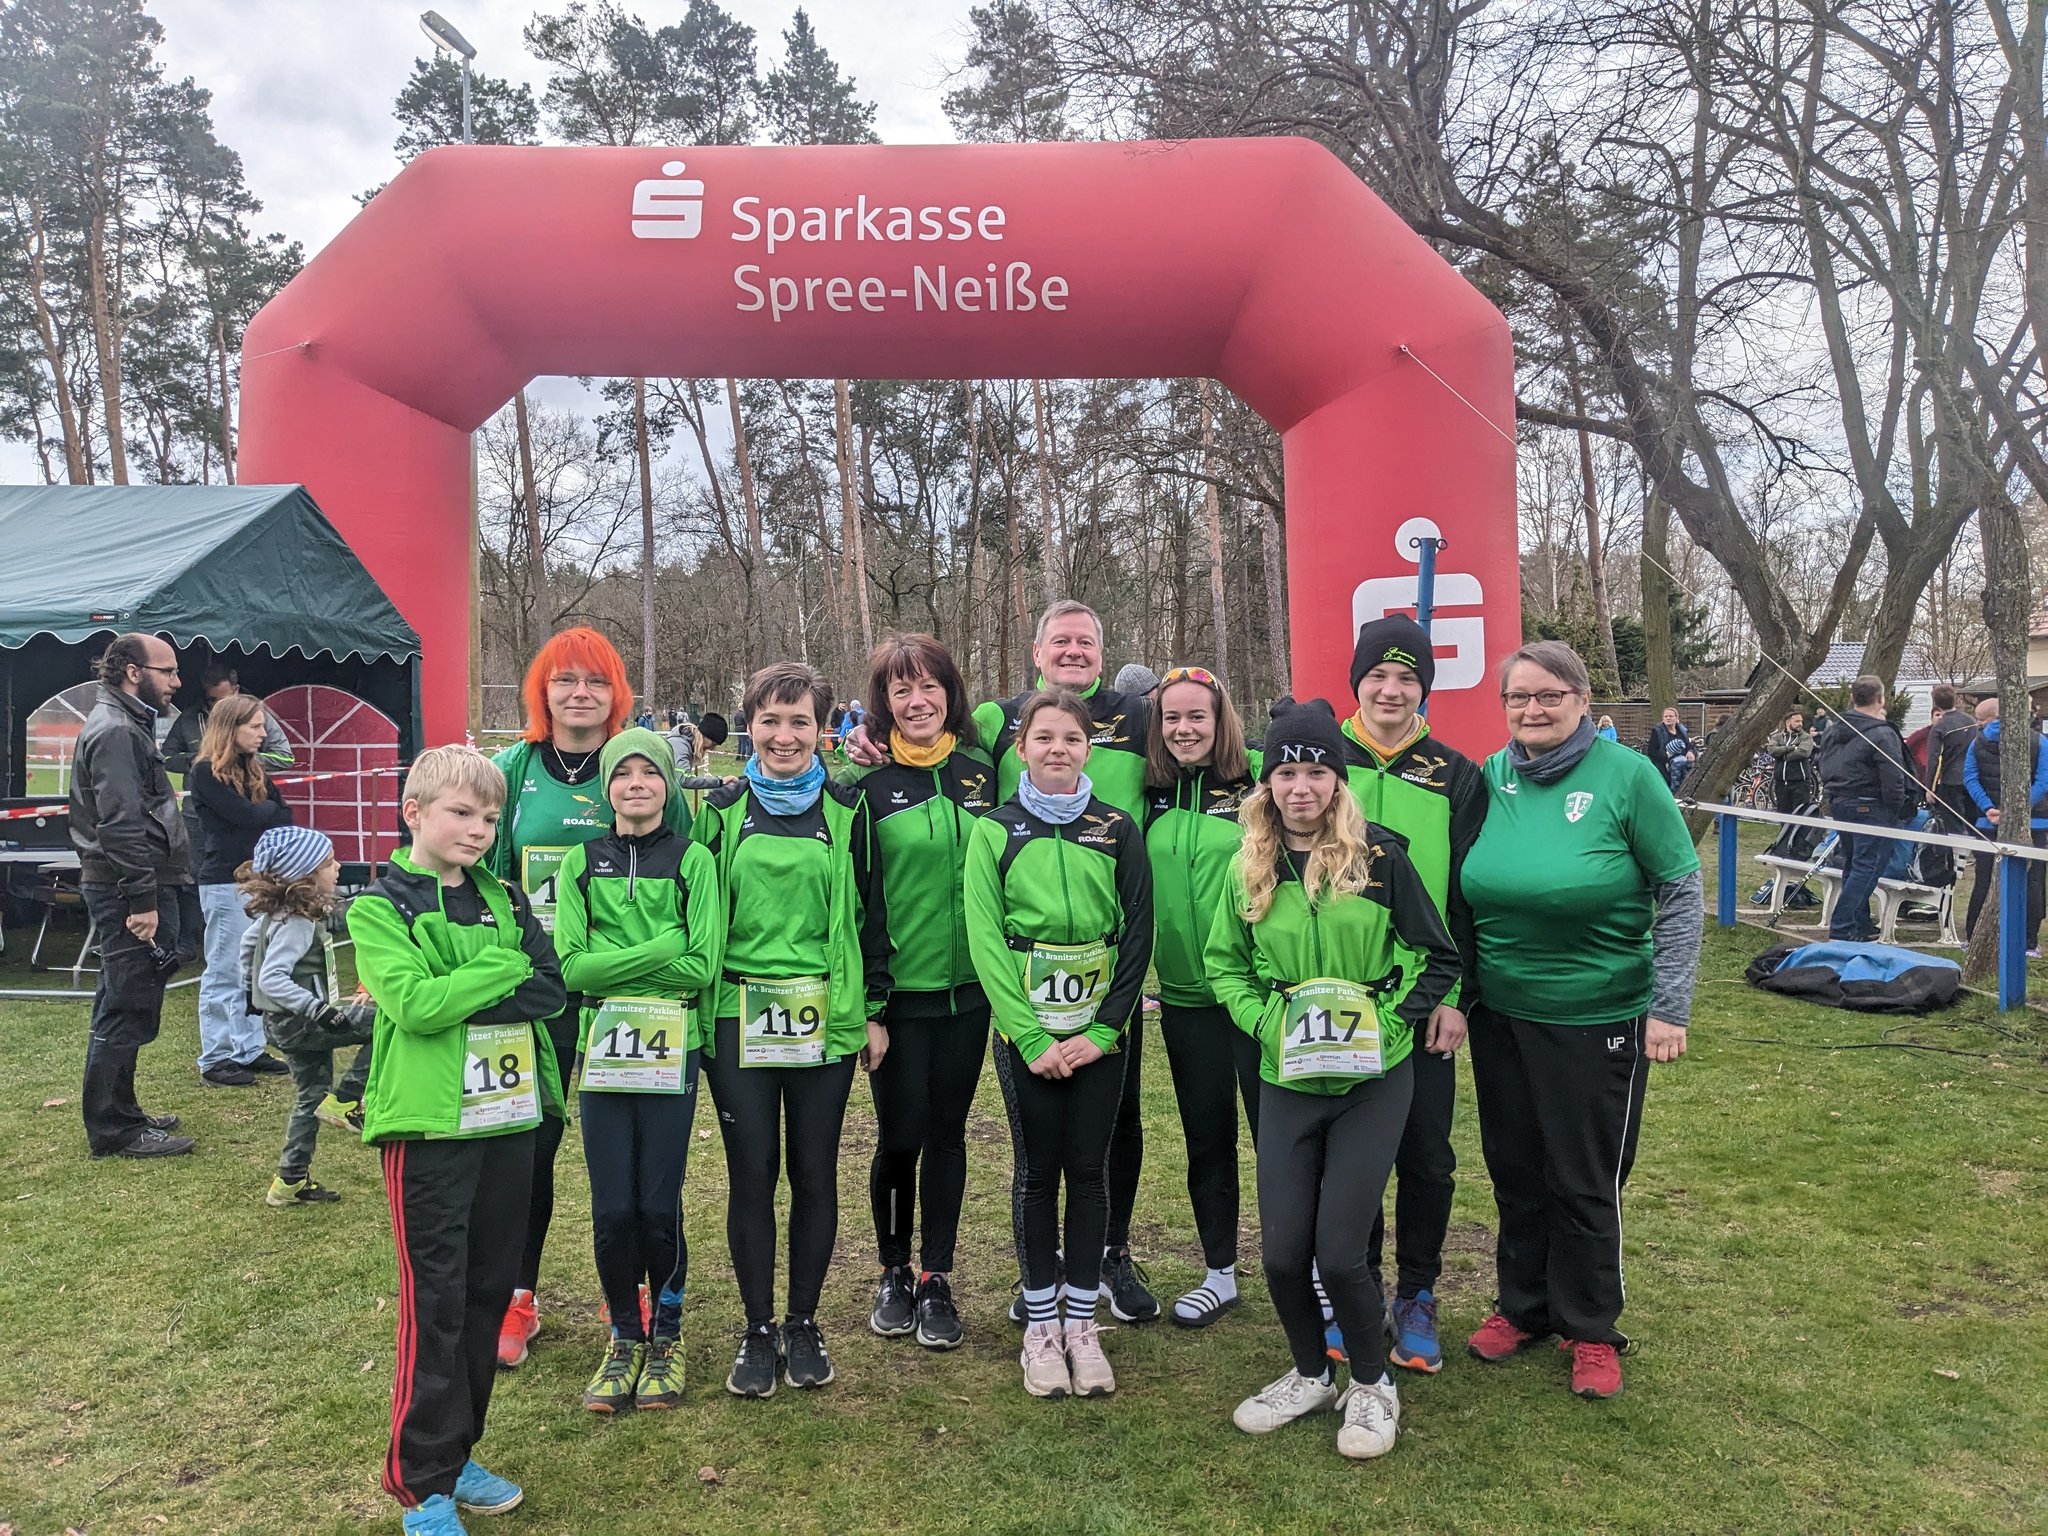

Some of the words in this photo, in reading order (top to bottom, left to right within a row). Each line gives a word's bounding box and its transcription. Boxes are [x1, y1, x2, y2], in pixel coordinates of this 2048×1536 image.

[731, 194, 1006, 254] Sparkasse
[734, 261, 1069, 322] Spree-Neiße
[1281, 744, 1326, 764] NY
[1033, 950, 1044, 959] 64.
[1045, 951, 1082, 961] Branitzer
[747, 985, 759, 993] 64.
[760, 985, 793, 995] Branitzer
[795, 982, 824, 993] Parklauf
[1042, 968, 1101, 1004] 107
[1299, 986, 1335, 998] Branitzer
[610, 1004, 647, 1014] Branitzer
[649, 1005, 682, 1016] Parklauf
[760, 1005, 820, 1037] 119
[494, 1026, 527, 1039] Parklauf
[1296, 1009, 1362, 1044] 117
[604, 1027, 670, 1060] 114
[1607, 1036, 1625, 1049] UP
[462, 1053, 521, 1095] 18
